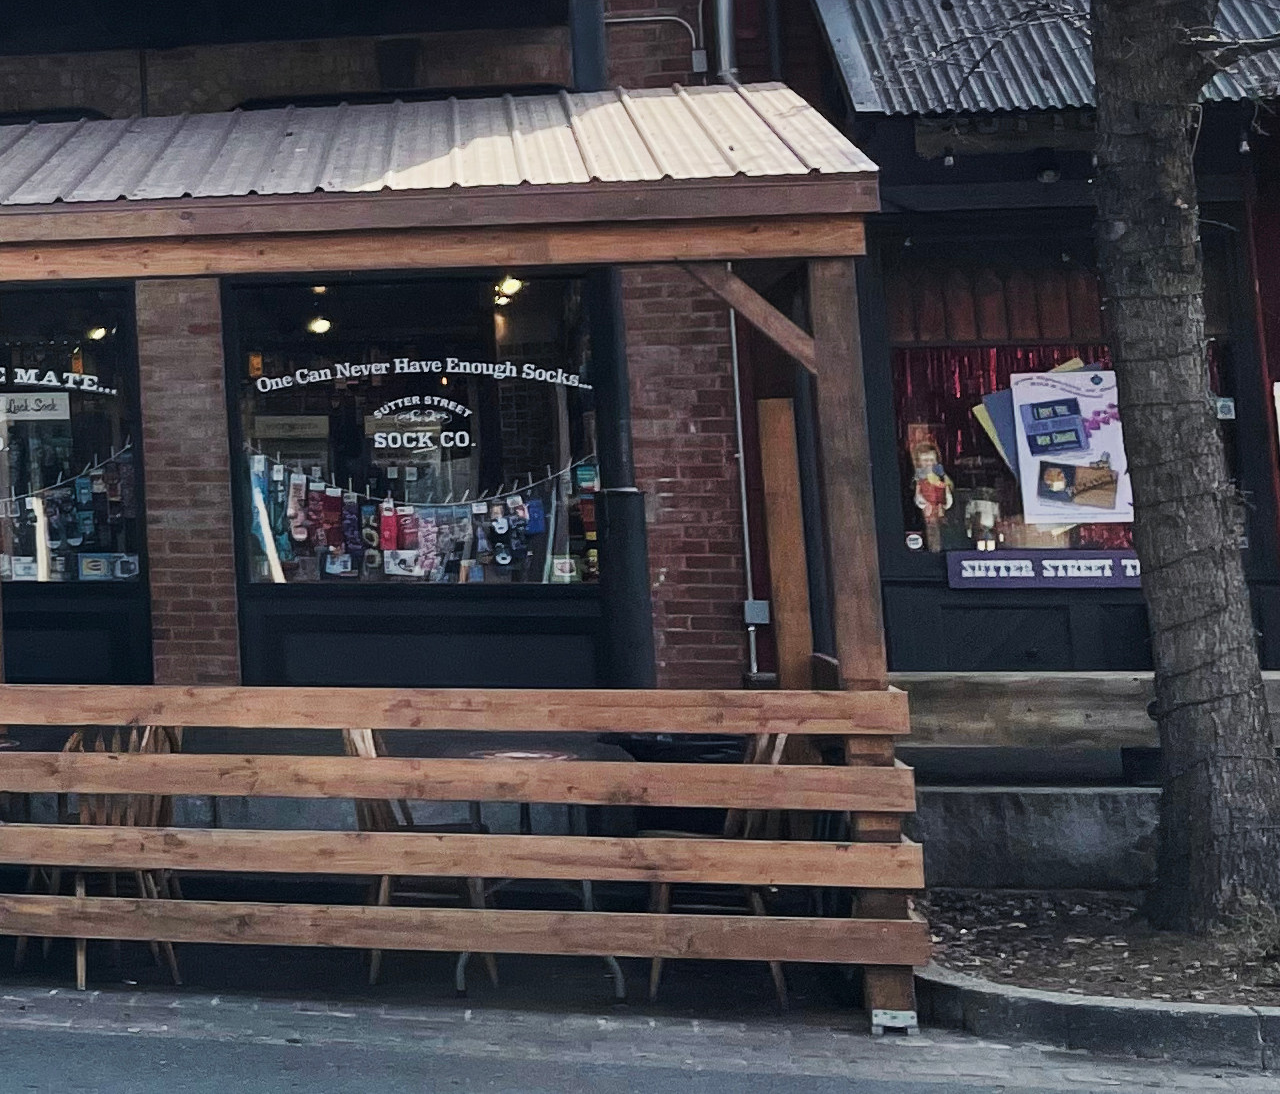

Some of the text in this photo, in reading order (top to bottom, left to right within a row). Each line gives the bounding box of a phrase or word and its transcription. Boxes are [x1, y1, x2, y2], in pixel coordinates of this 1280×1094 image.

[13, 368, 118, 395] MATE...
[256, 358, 593, 393] One Can Never Have Enough Socks...
[373, 395, 473, 419] SUTTER STREET
[374, 432, 476, 448] SOCK CO.
[961, 559, 1035, 577] SUTTER
[1042, 559, 1113, 577] STREET
